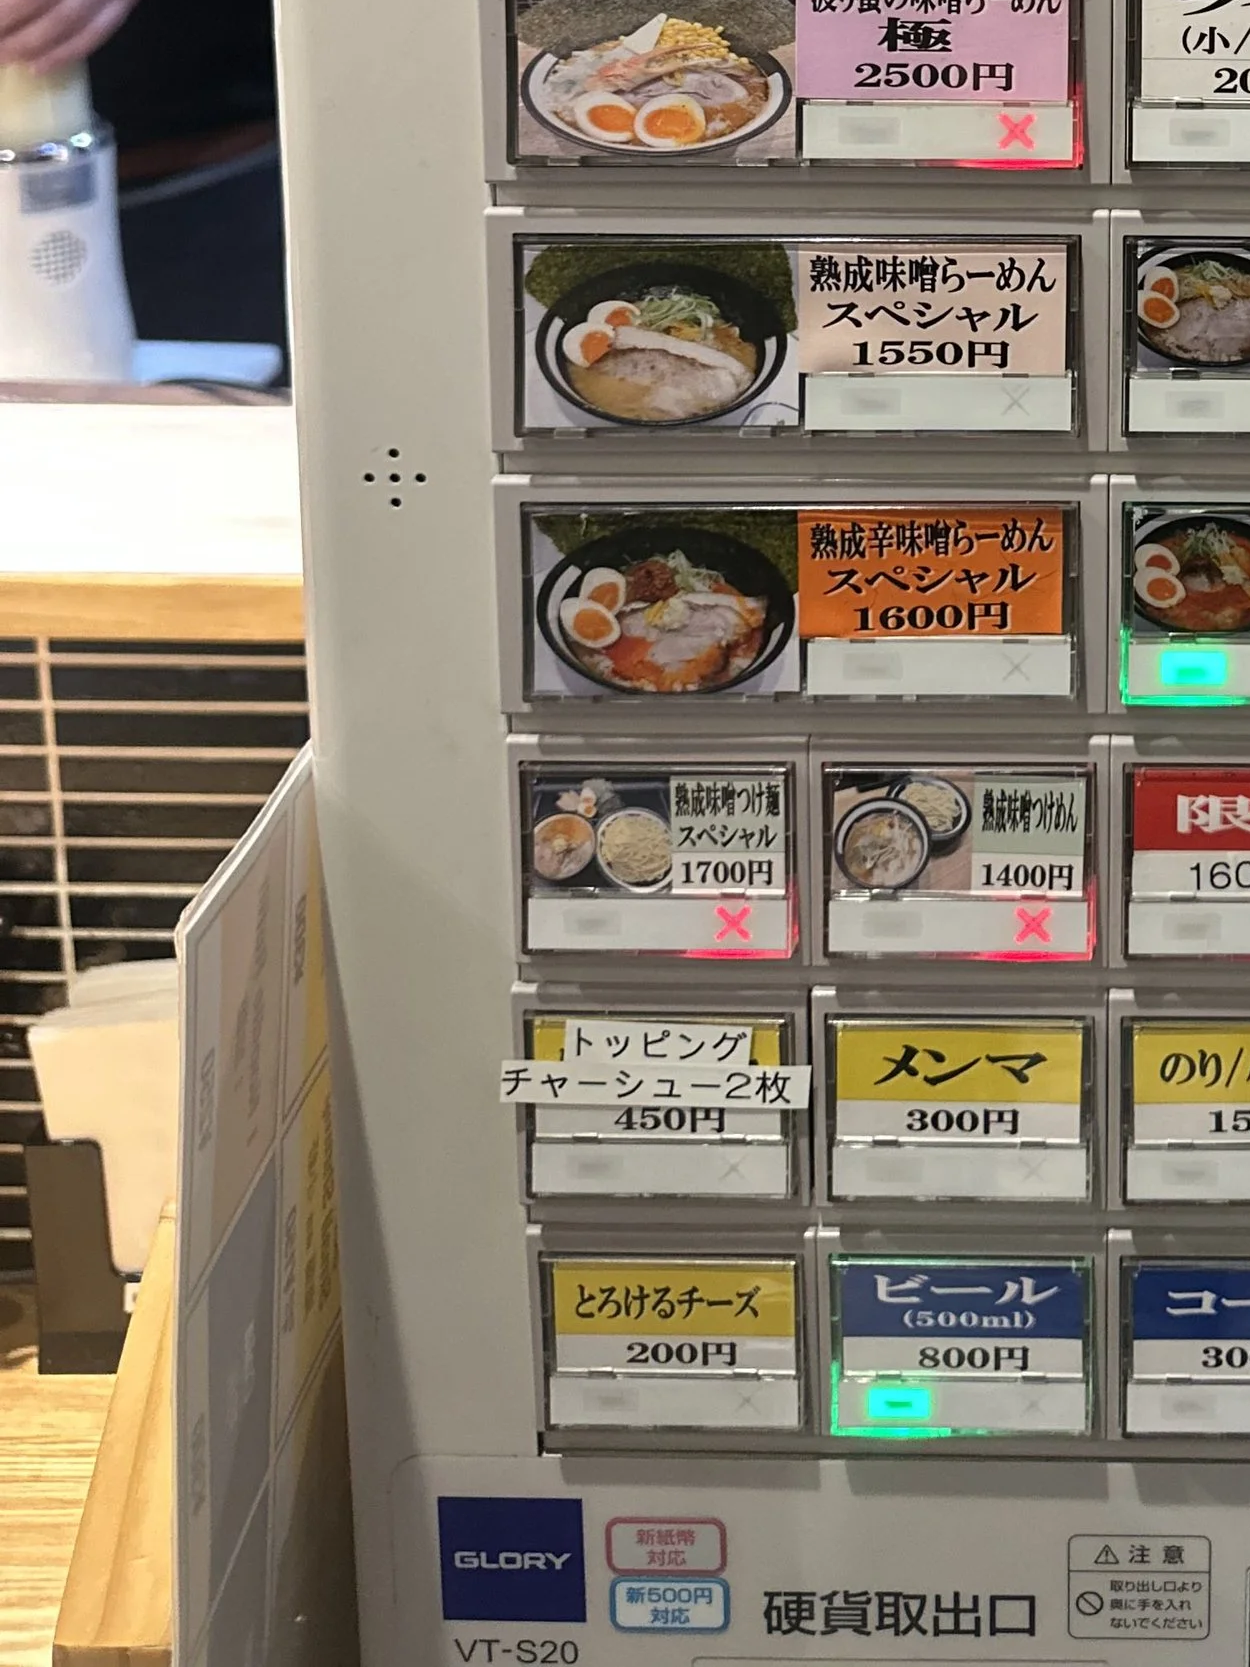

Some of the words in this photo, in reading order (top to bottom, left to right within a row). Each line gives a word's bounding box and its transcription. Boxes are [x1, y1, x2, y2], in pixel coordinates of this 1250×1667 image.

[877, 16, 953, 52] 極
[854, 62, 1014, 91] 2500円
[809, 254, 1057, 293] 熟成味噌らーめん
[822, 300, 1039, 332] スペシャル
[852, 340, 1010, 369] 1550円
[810, 517, 1054, 560] 熟成辛味噌らーめん
[823, 563, 1037, 595] スペシャル
[853, 601, 1009, 631] 1600円
[982, 788, 1078, 834] 熟成味噌つけめん
[678, 824, 778, 849] スペシャル
[681, 859, 774, 885] 1700円
[981, 863, 1074, 891] 1400円
[575, 1026, 747, 1060] トッピング
[874, 1044, 1049, 1086] メンマ
[502, 1069, 791, 1105] チャーシュー2枚
[614, 1106, 726, 1133] 450円
[906, 1108, 1020, 1135] 300円
[574, 1283, 762, 1321] とろけるチーズ
[874, 1273, 1060, 1306] ビール
[903, 1309, 1038, 1330] (500ml)
[626, 1340, 738, 1367] 200円
[918, 1345, 1030, 1373] 800円
[635, 1528, 696, 1547] 新紙幣
[454, 1550, 573, 1571] GLORY
[646, 1548, 687, 1567] 対応
[625, 1586, 713, 1605] 新500円
[1109, 1579, 1204, 1594] 取り出し口より
[649, 1607, 691, 1625] 対応
[763, 1589, 1037, 1637] 硬貨取出口
[1109, 1597, 1193, 1612] 奥に手を入れ
[1109, 1615, 1204, 1631] ないでください
[454, 1638, 580, 1665] VT-S20
